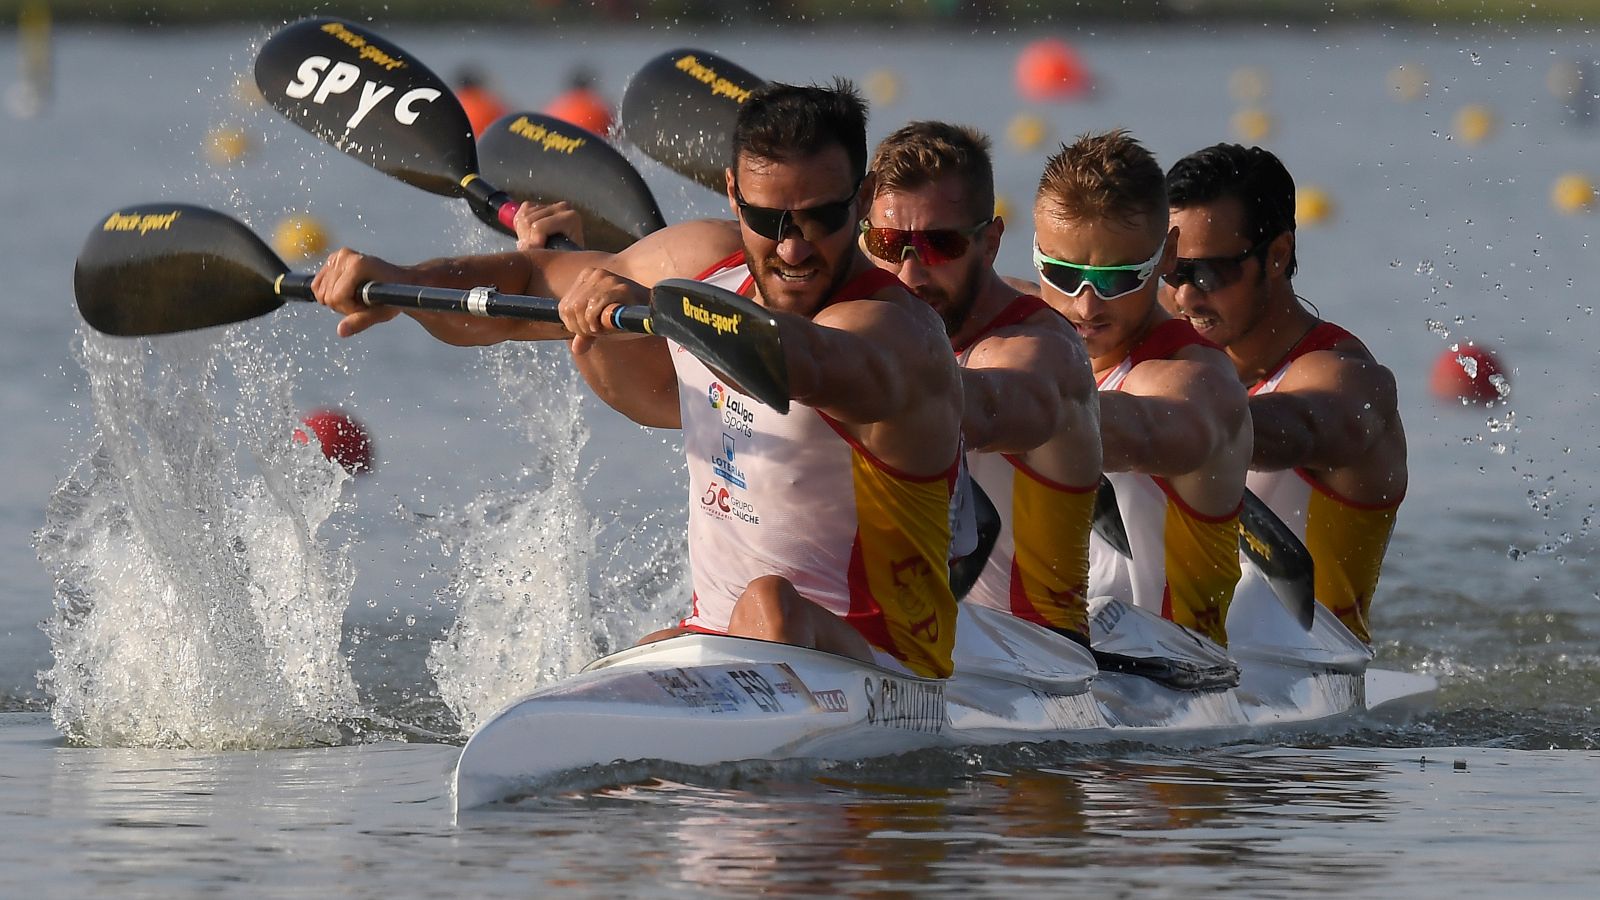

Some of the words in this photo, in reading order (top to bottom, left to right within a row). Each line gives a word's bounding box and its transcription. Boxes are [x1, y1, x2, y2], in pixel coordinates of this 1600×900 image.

[726, 395, 754, 423] LaLiga
[724, 411, 752, 438] Sports
[731, 496, 754, 513] GRUPO
[727, 669, 784, 713] ESP
[814, 692, 847, 710] NELO
